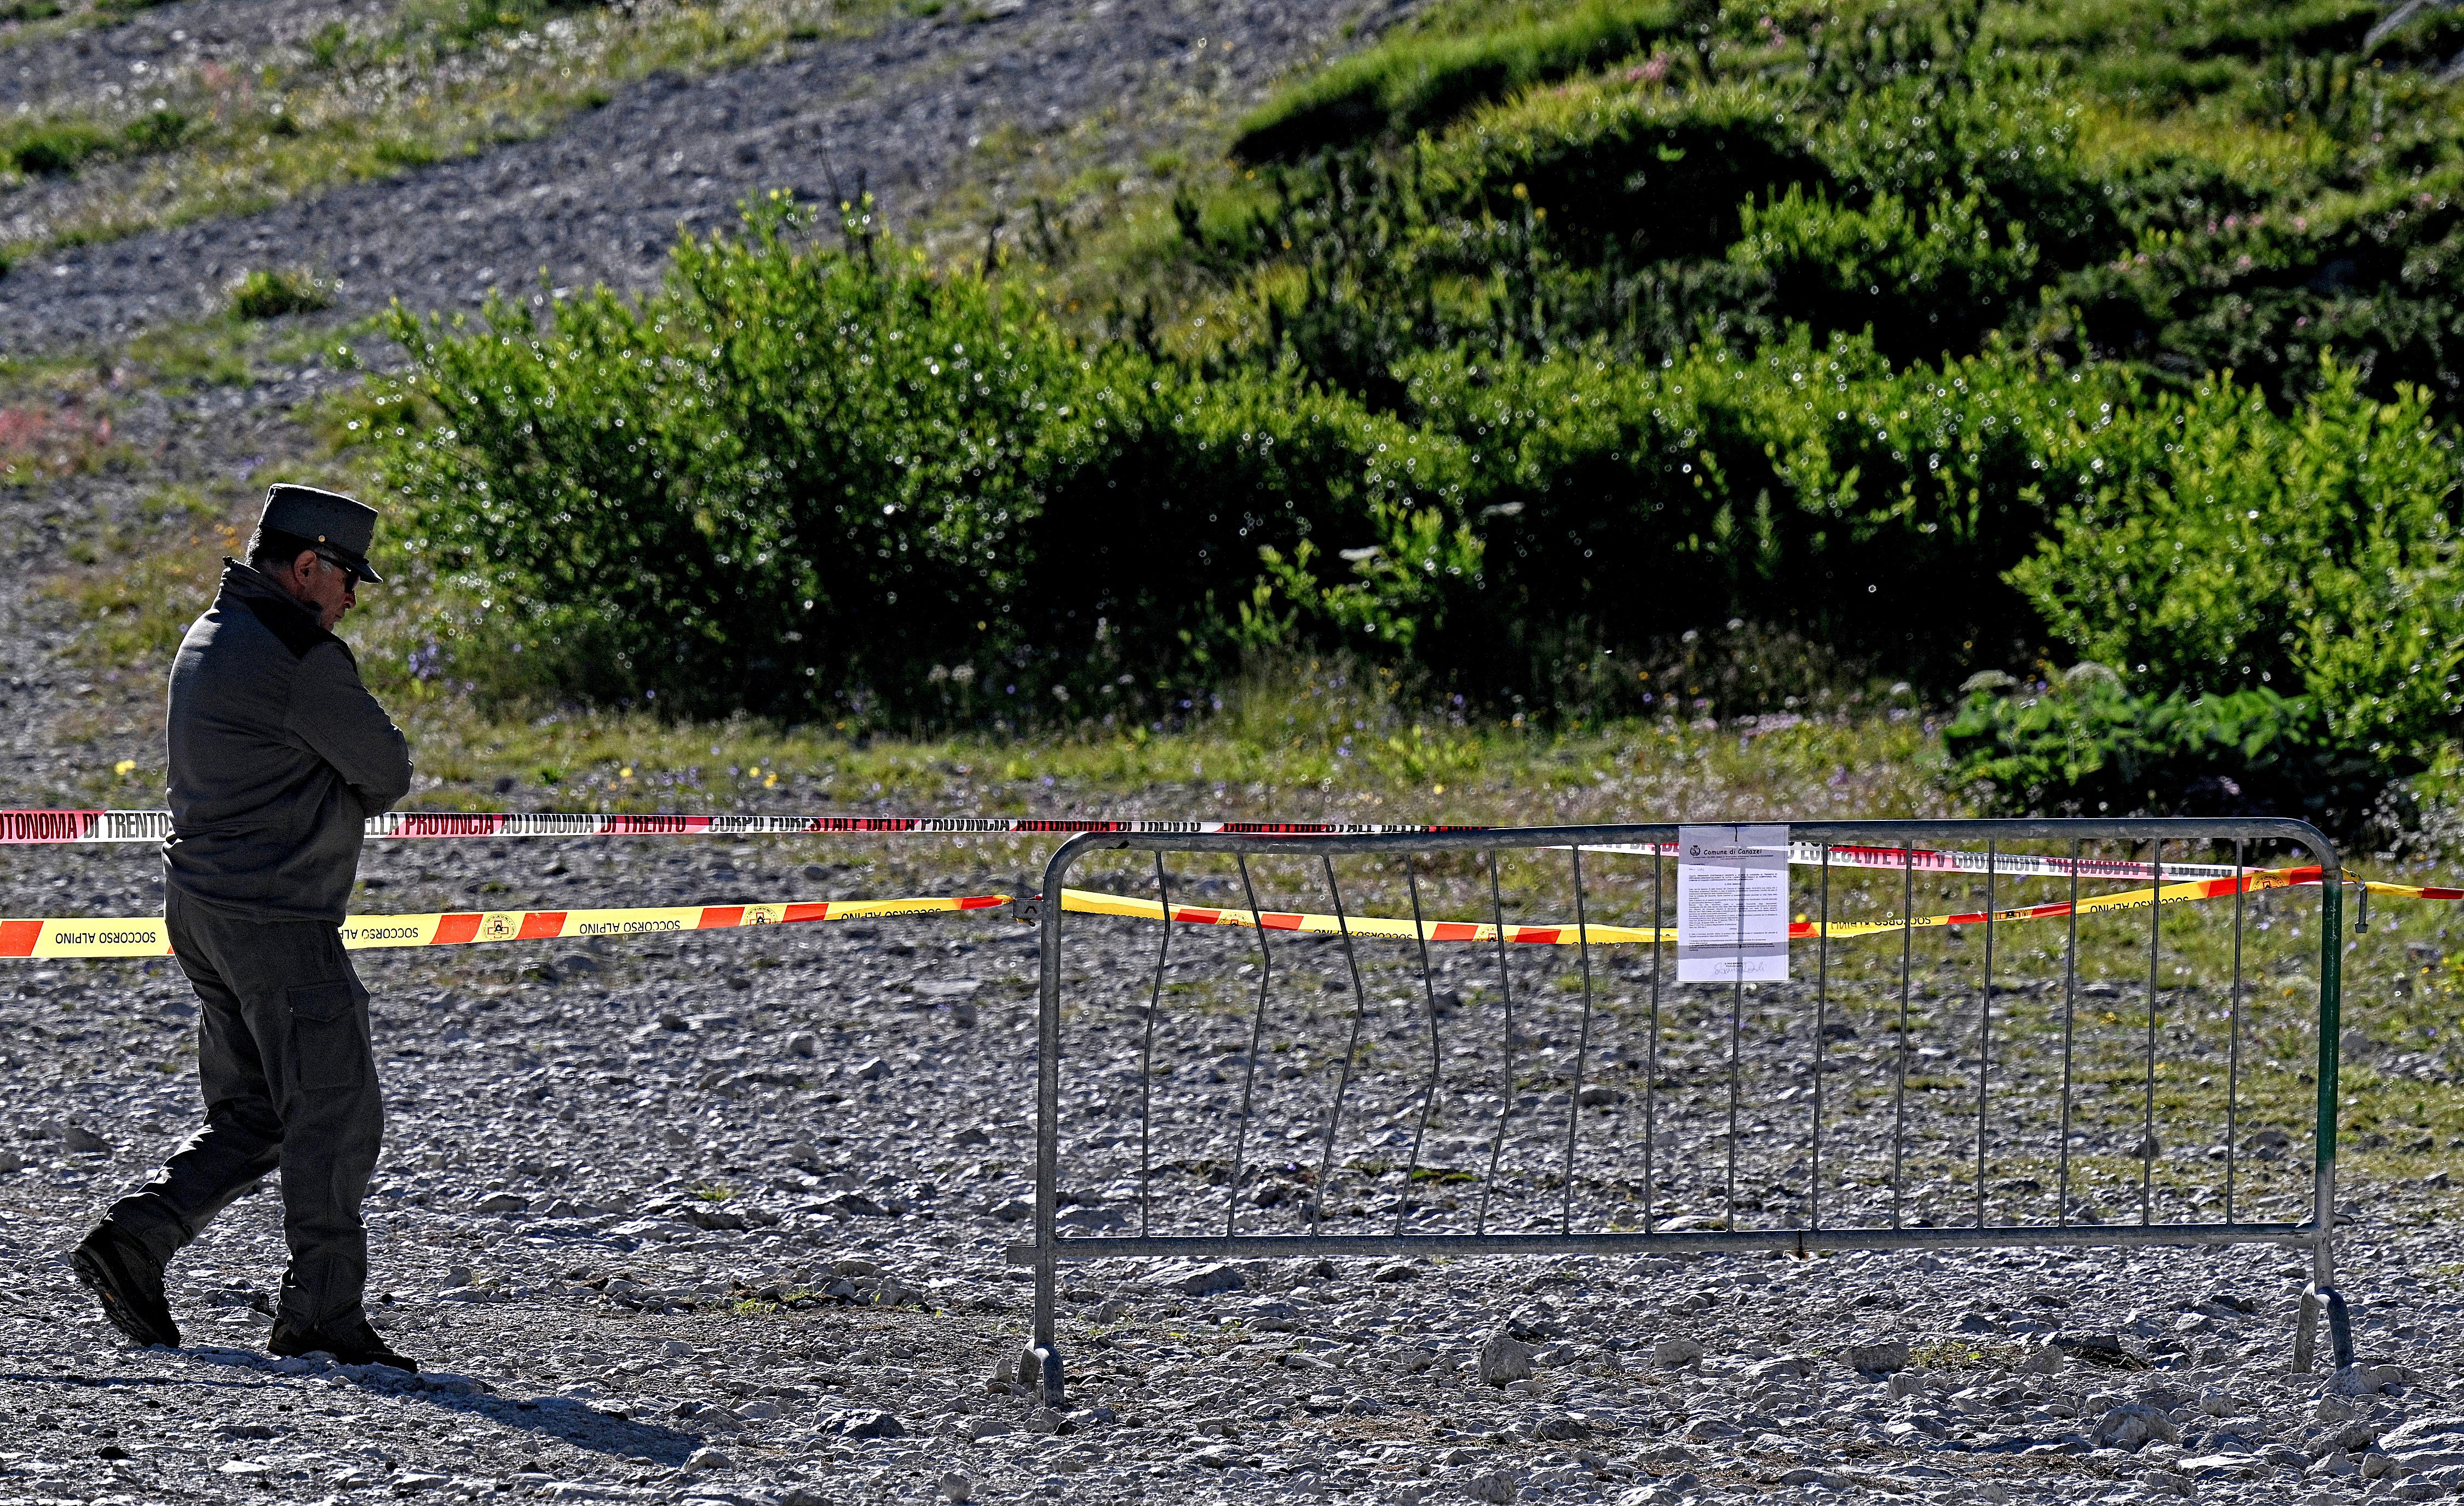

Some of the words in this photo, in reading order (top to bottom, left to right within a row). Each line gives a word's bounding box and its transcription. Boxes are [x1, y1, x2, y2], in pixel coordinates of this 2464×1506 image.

[83, 813, 99, 838] DI
[104, 812, 169, 838] TRENTO
[405, 813, 493, 835] PROVINCIA
[499, 814, 594, 834] AUTONOMA
[601, 815, 617, 832] DI
[624, 815, 687, 833] TRENTO
[579, 922, 620, 934] ALPINO
[624, 920, 680, 932] SOCCORSO
[55, 933, 96, 944] ALPINO
[99, 932, 156, 944] SOCCORSO
[361, 928, 418, 939] SOCCORSO
